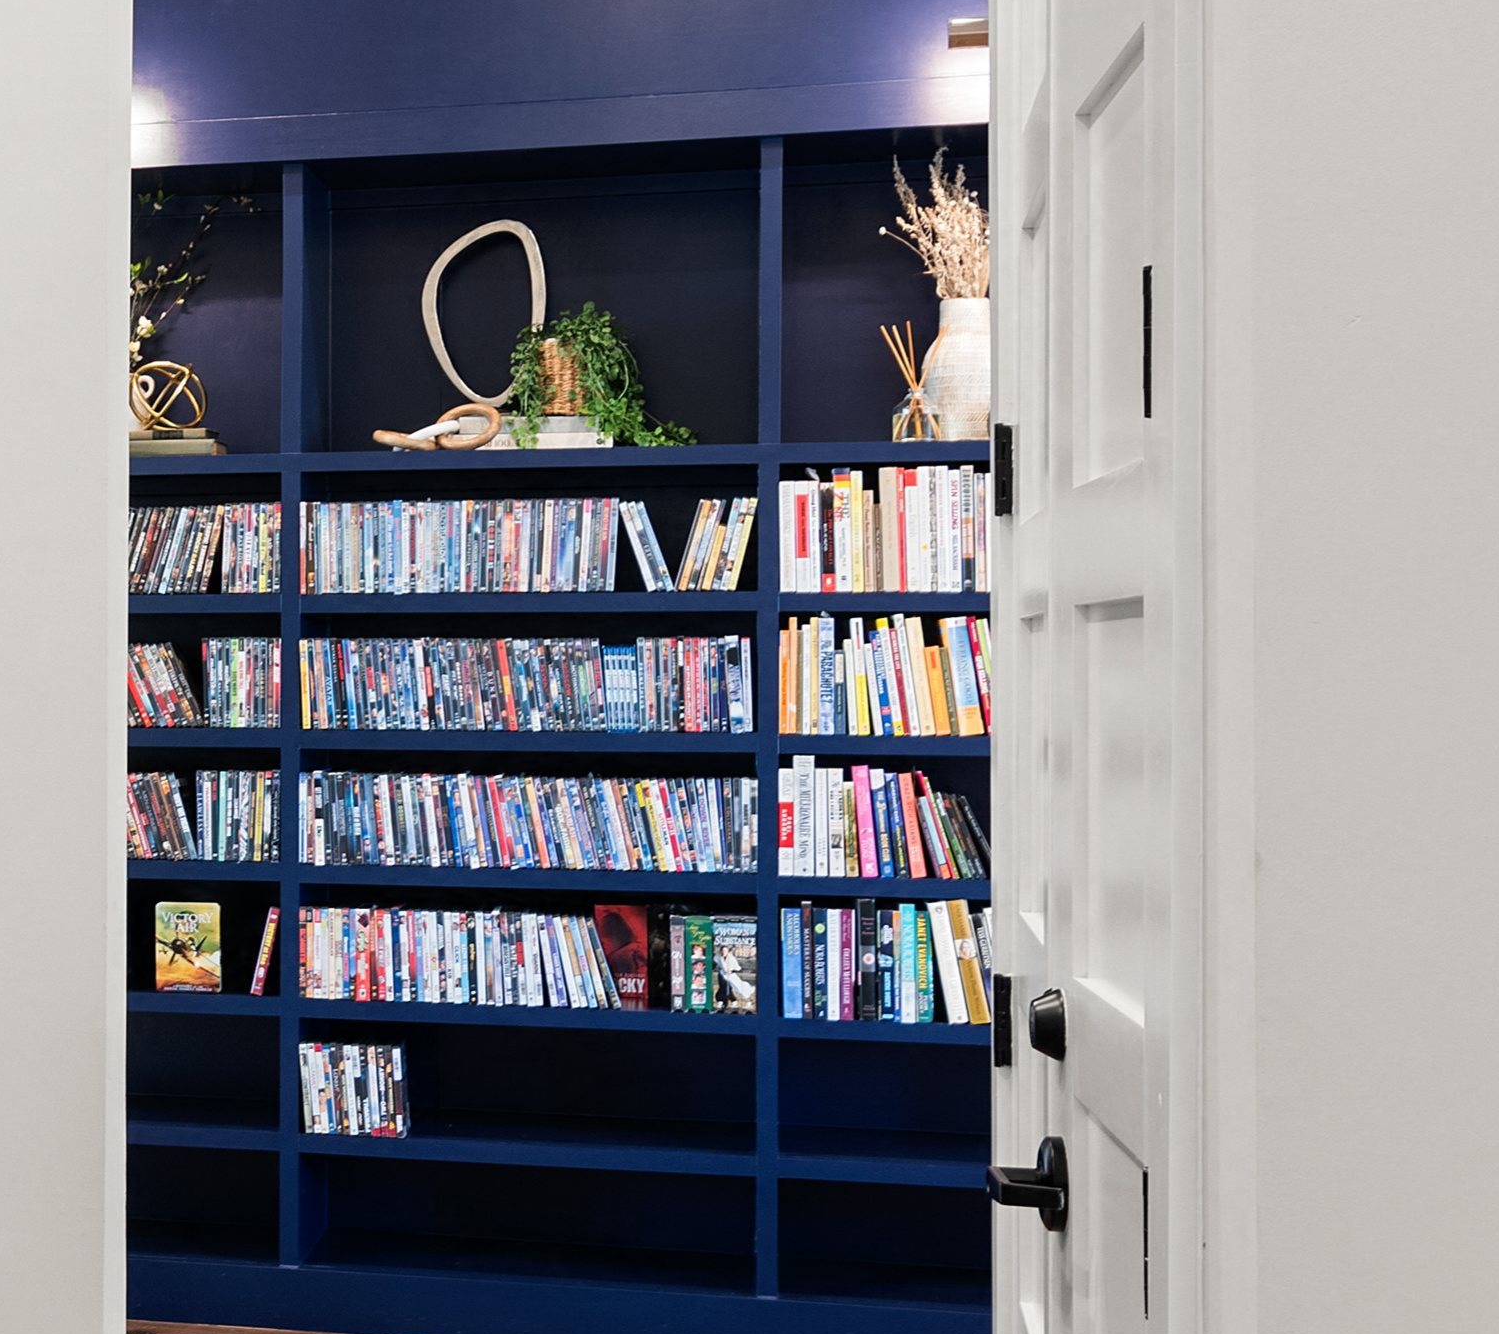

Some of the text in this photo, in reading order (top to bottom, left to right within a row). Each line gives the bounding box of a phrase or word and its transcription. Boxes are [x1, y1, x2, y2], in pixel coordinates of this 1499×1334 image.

[951, 480, 959, 497] SPIN
[963, 469, 972, 513] EXECUTION
[951, 501, 959, 530] SELLING
[487, 671, 496, 698] DUNE
[821, 651, 833, 704] PARACHUTE?
[958, 640, 973, 703] FEELING GOOD
[325, 676, 333, 706] AVATAR
[799, 789, 812, 838] MILLIONAIRE
[904, 778, 917, 845] CRAZY RICH ASIANS
[162, 911, 213, 924] VICTORY
[177, 923, 199, 934] AIR
[264, 923, 276, 947] VICTORY
[843, 948, 851, 970] COLLEEN
[917, 918, 927, 989] JANET EVANOVICH
[617, 977, 645, 994] CKY
[378, 1067, 386, 1091] MONEY
